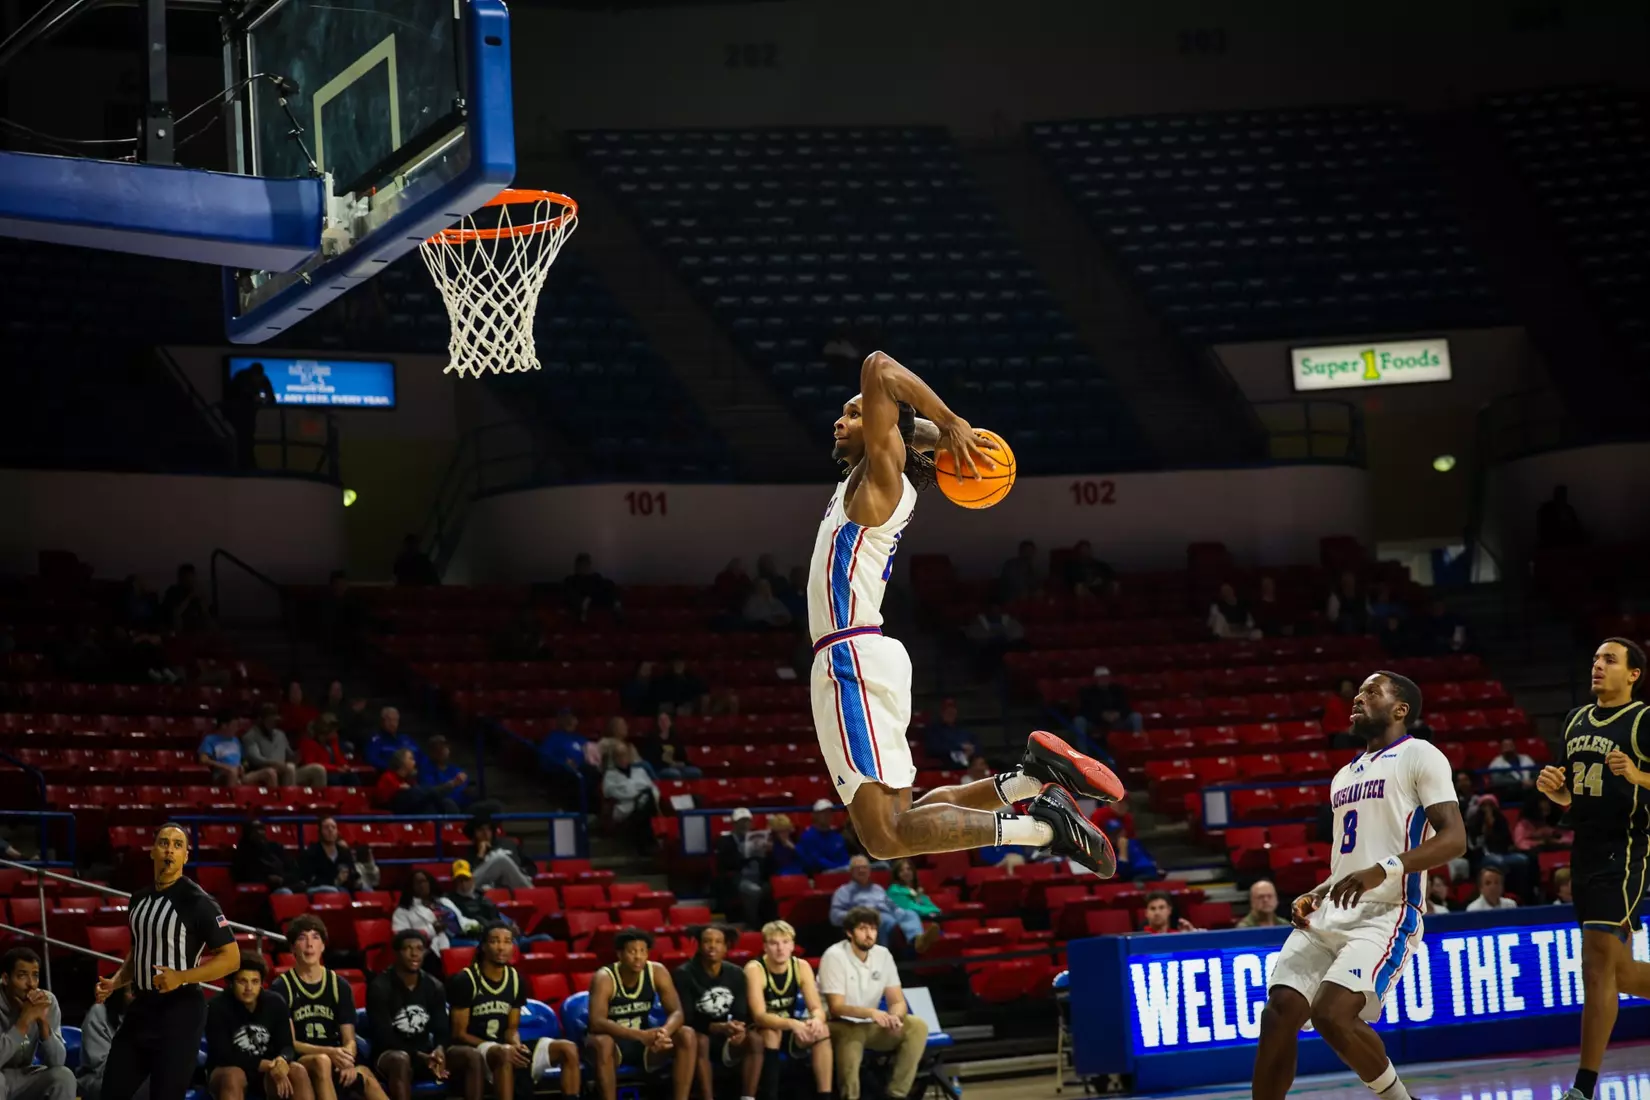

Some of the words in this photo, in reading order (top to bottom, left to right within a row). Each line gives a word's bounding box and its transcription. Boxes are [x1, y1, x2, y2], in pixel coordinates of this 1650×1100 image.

[1301, 357, 1359, 379] Super
[1360, 348, 1381, 380] 1
[1380, 349, 1441, 370] Foods
[624, 490, 668, 516] 101
[1069, 481, 1117, 505] 102
[1362, 779, 1386, 799] TECH
[1572, 762, 1604, 797] 24
[1340, 809, 1358, 854] 8
[1129, 953, 1281, 1048] WELC
[1442, 933, 1525, 1017] THE
